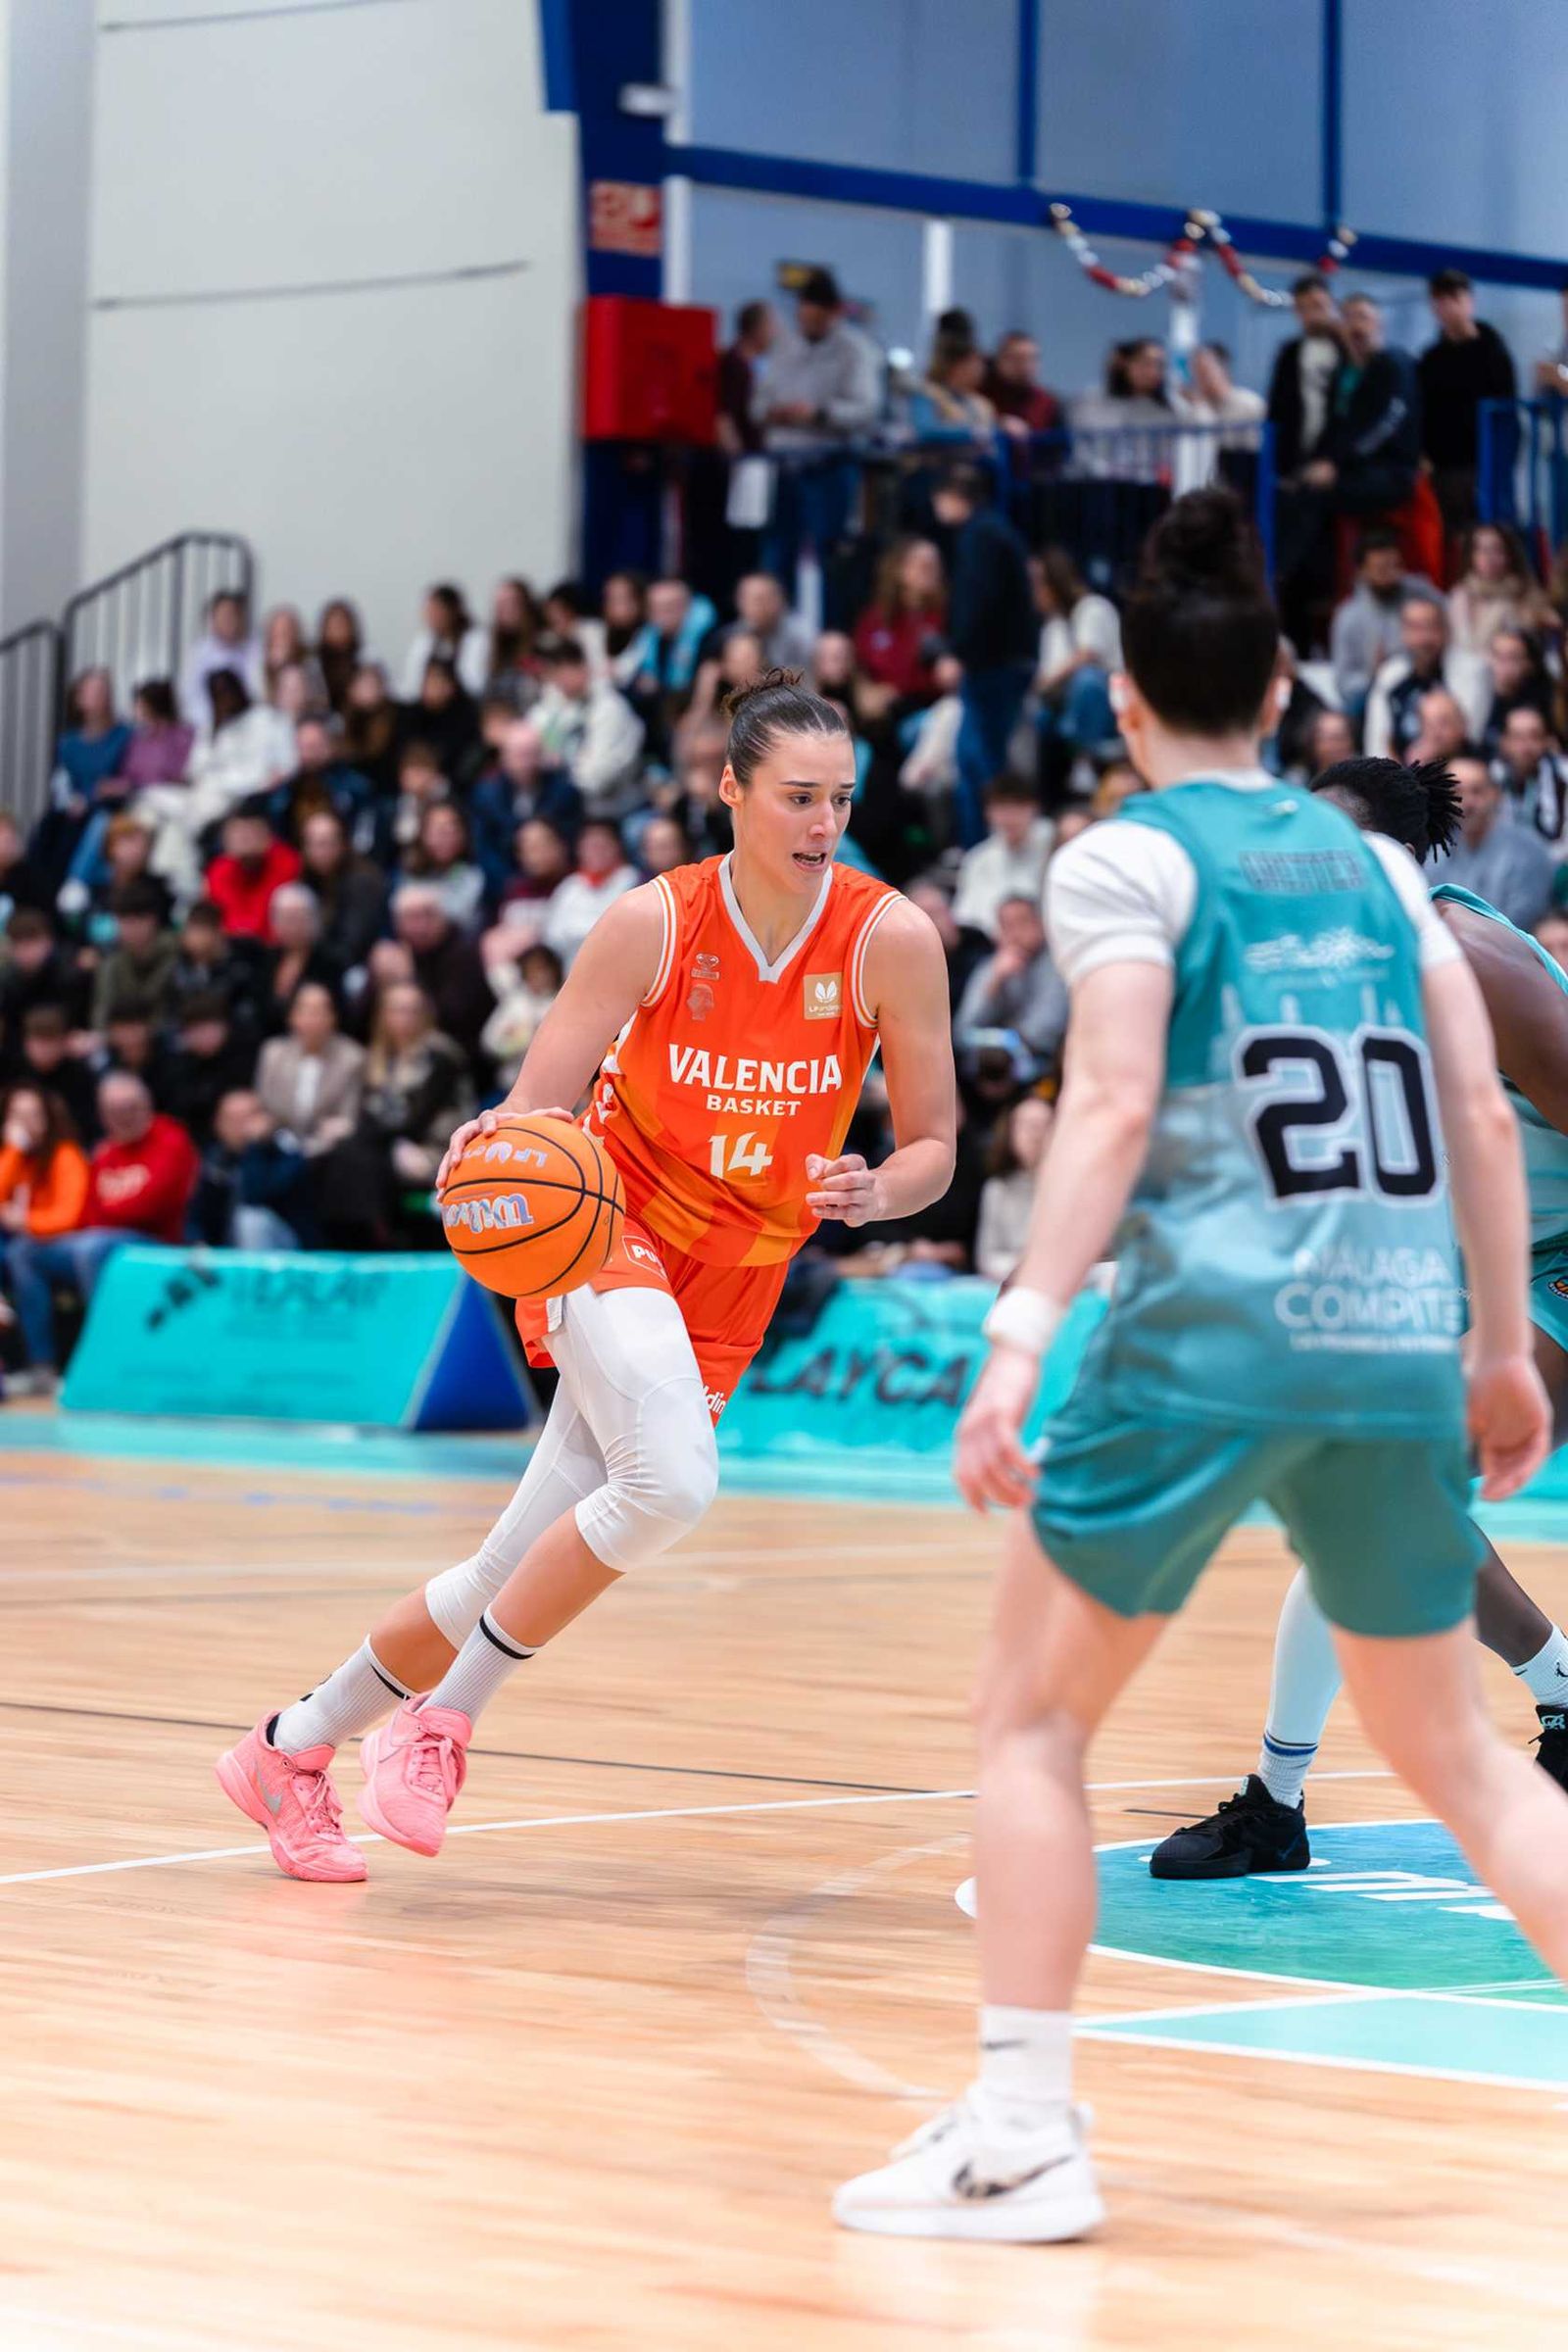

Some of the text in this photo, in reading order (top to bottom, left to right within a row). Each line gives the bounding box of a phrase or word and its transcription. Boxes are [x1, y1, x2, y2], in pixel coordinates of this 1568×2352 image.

[668, 1044, 842, 1094] VALENCIA
[706, 1094, 802, 1116] BASKET
[1233, 1025, 1446, 1209] 20
[708, 1131, 773, 1179] 14
